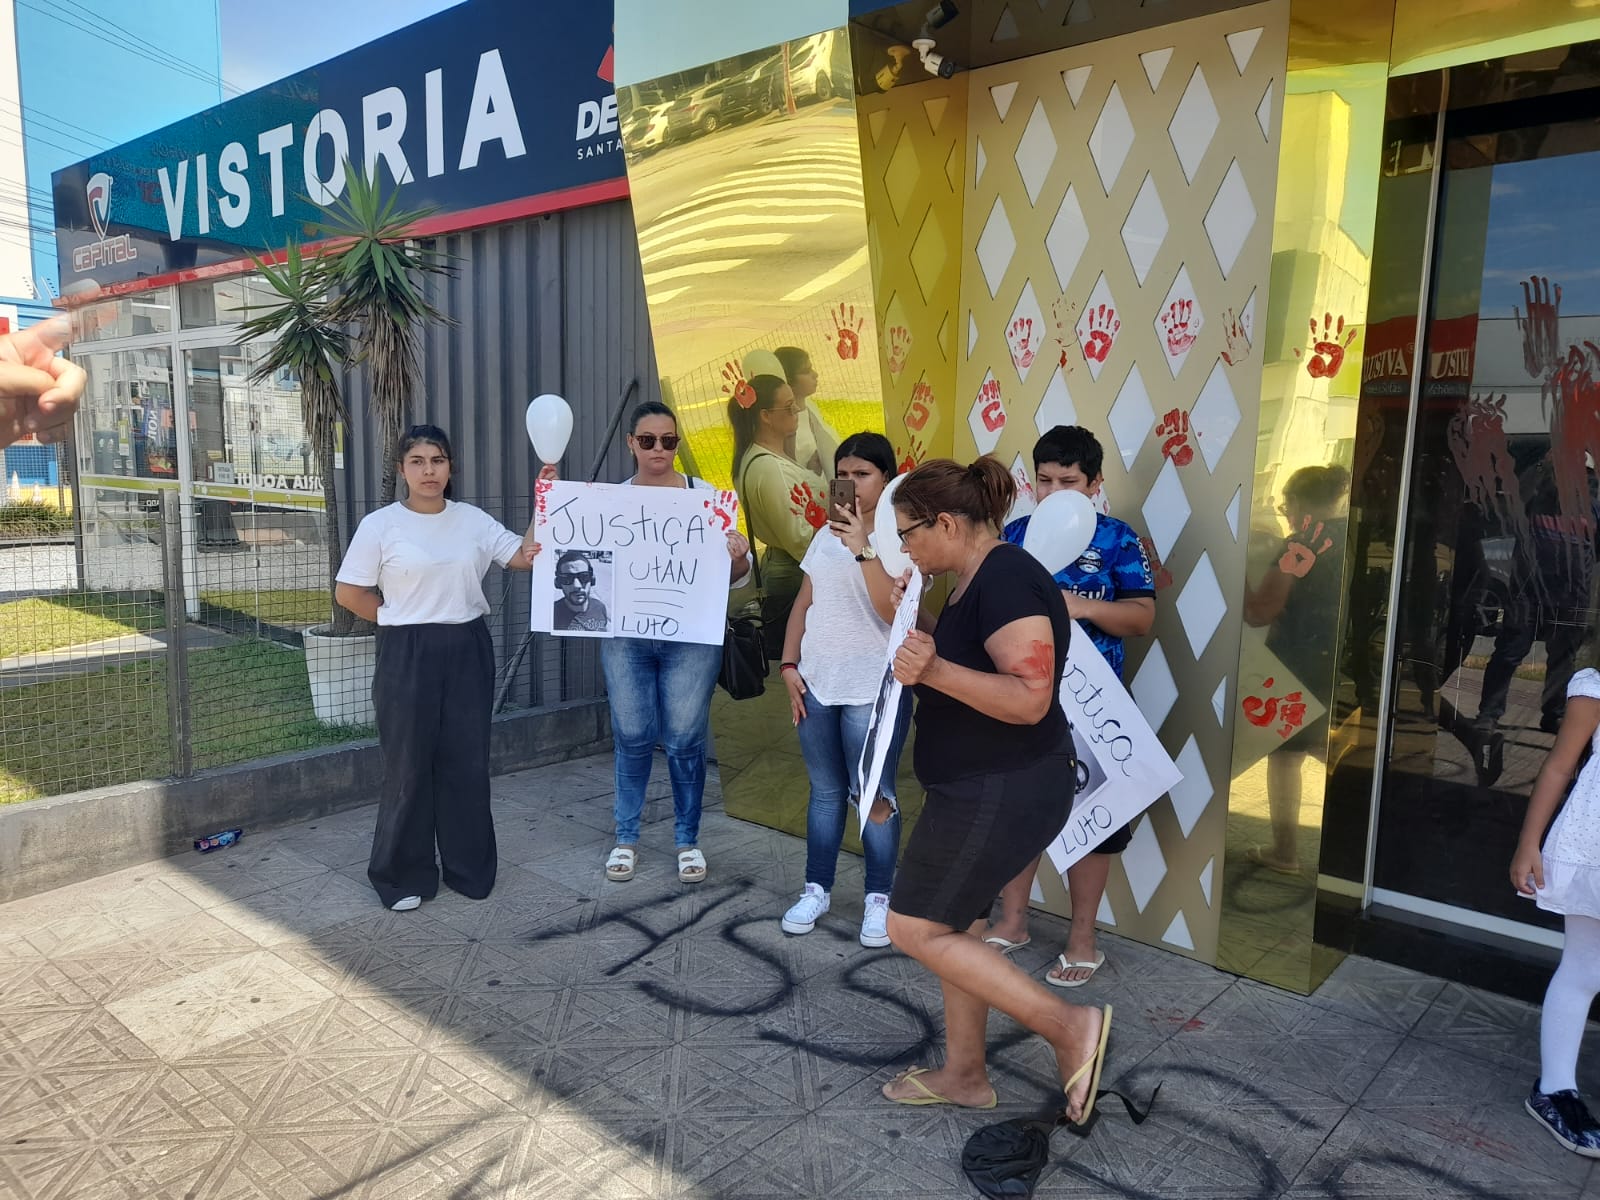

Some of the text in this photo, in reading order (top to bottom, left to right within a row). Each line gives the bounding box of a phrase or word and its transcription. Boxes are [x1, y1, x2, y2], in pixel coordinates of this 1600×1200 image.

[157, 48, 527, 242] VISTORIA
[577, 138, 624, 160] SANTA
[72, 233, 137, 273] CAPITAL
